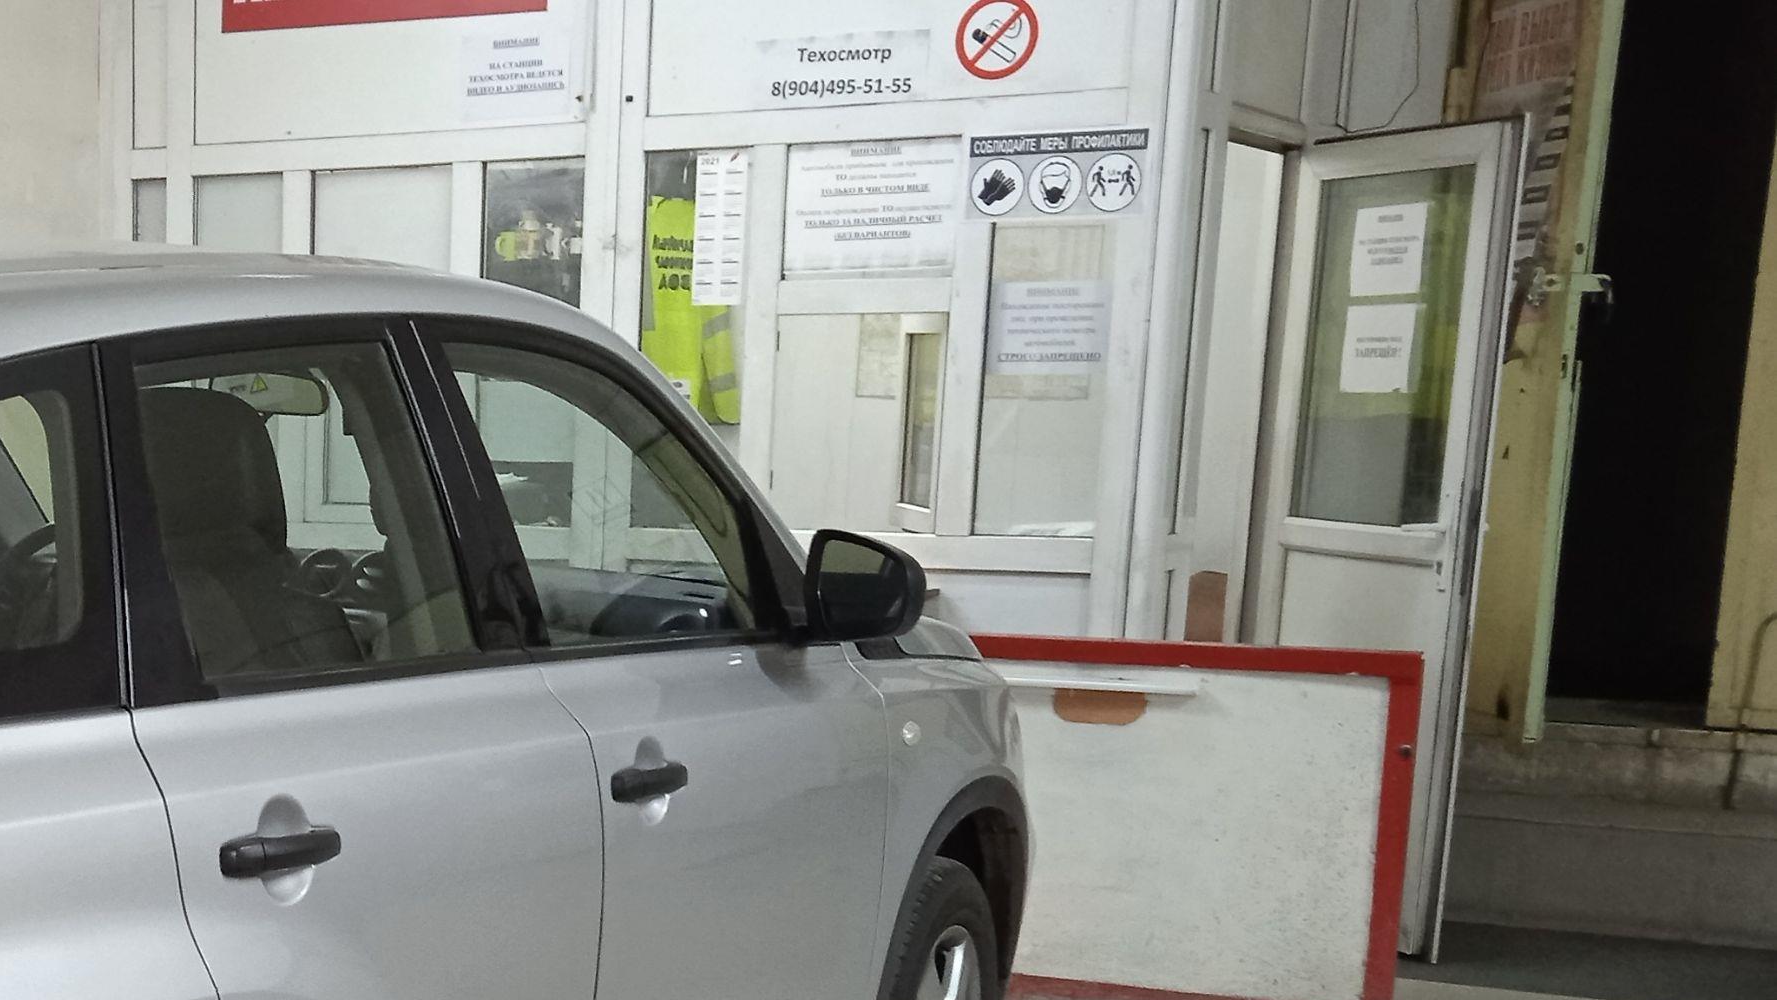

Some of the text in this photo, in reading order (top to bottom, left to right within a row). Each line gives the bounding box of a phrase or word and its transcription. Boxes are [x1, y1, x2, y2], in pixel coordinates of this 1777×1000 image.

[493, 37, 540, 49] ВНИМАНИЕ
[797, 48, 892, 63] Техосмотр
[489, 59, 543, 70] НА СТАНЦИИ
[469, 72, 525, 83] ТЕХОСМОТРА
[771, 77, 912, 99] 8(904)495-51-55
[973, 131, 1145, 154] СОБЛЮДАЙТЕ МЕРЫ ПРОФИЛАКТИКИ
[701, 157, 720, 165] 2021
[821, 186, 856, 197] ТОЛЬКО
[865, 184, 904, 195] ЧИСТОМ
